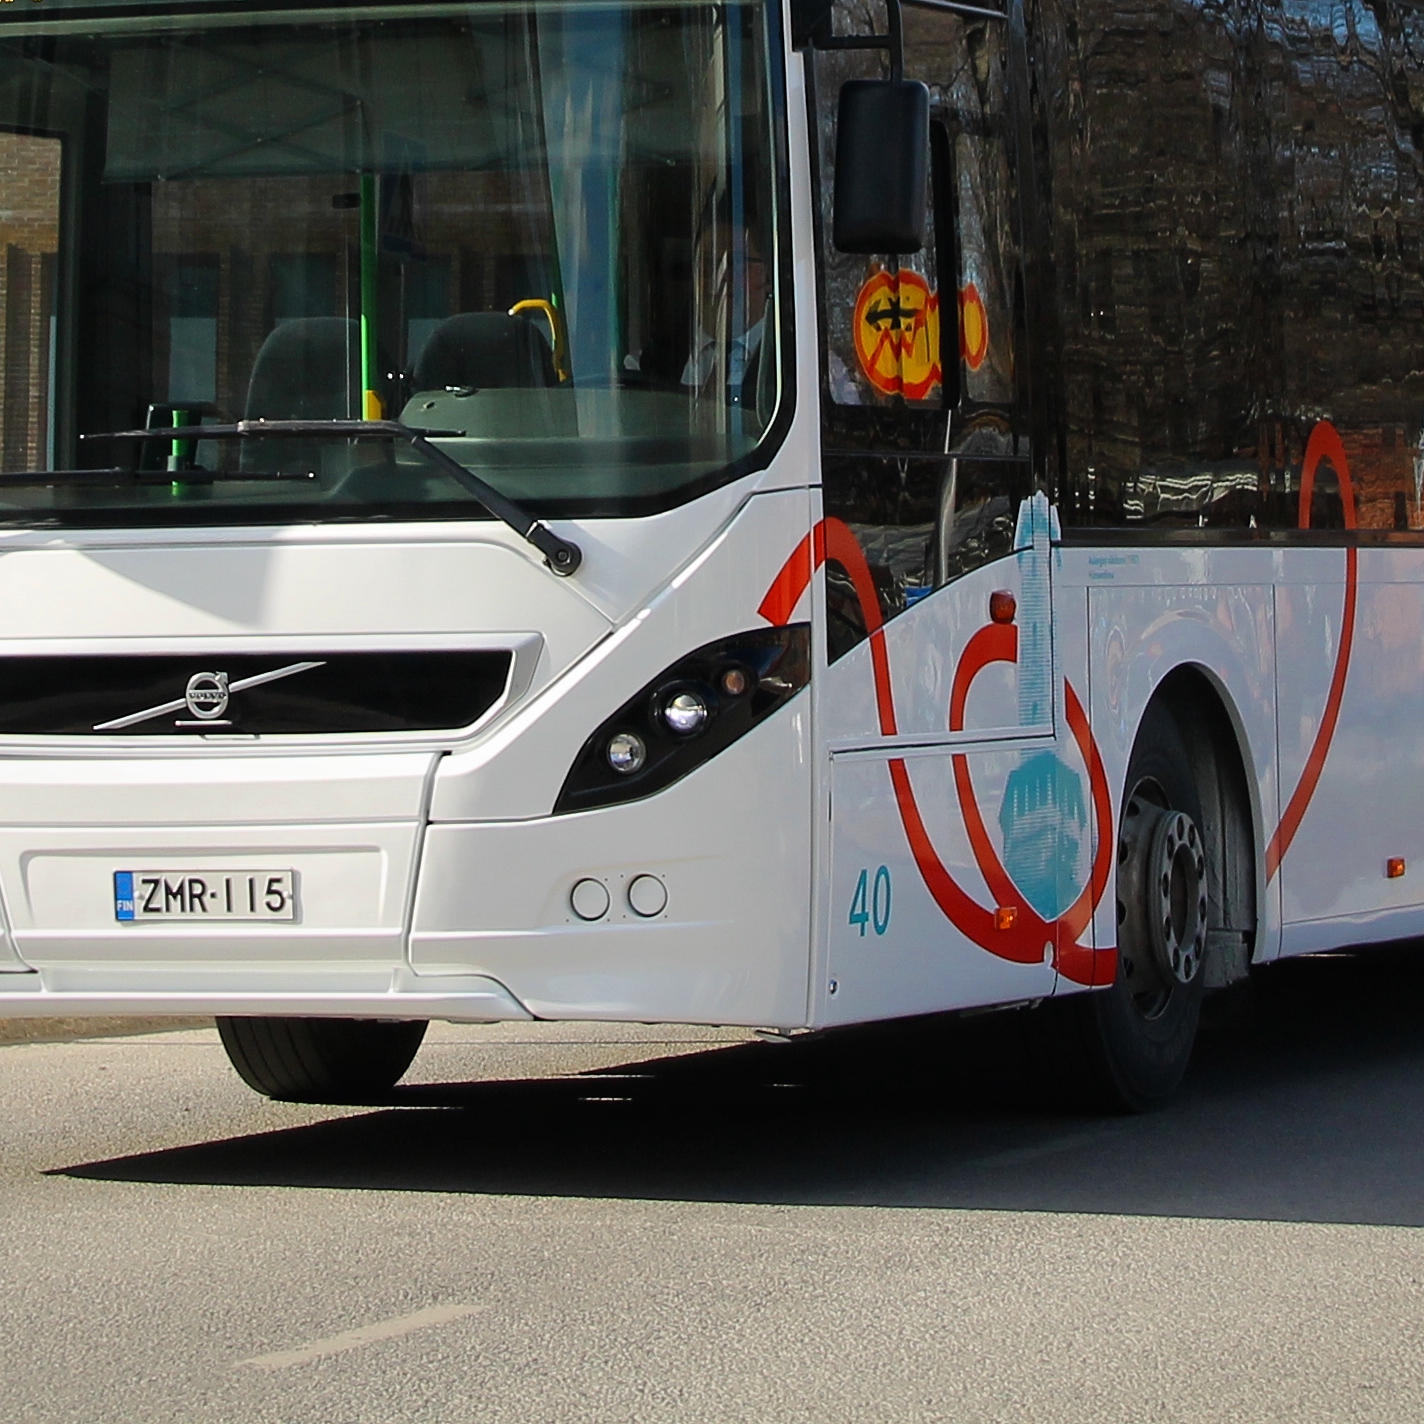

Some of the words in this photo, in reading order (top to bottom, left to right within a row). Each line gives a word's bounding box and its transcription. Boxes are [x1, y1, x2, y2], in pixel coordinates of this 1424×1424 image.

[189, 691, 227, 700] VOLVO
[116, 900, 134, 911] FIN
[141, 878, 286, 913] ZMR-115
[849, 865, 892, 936] 40
